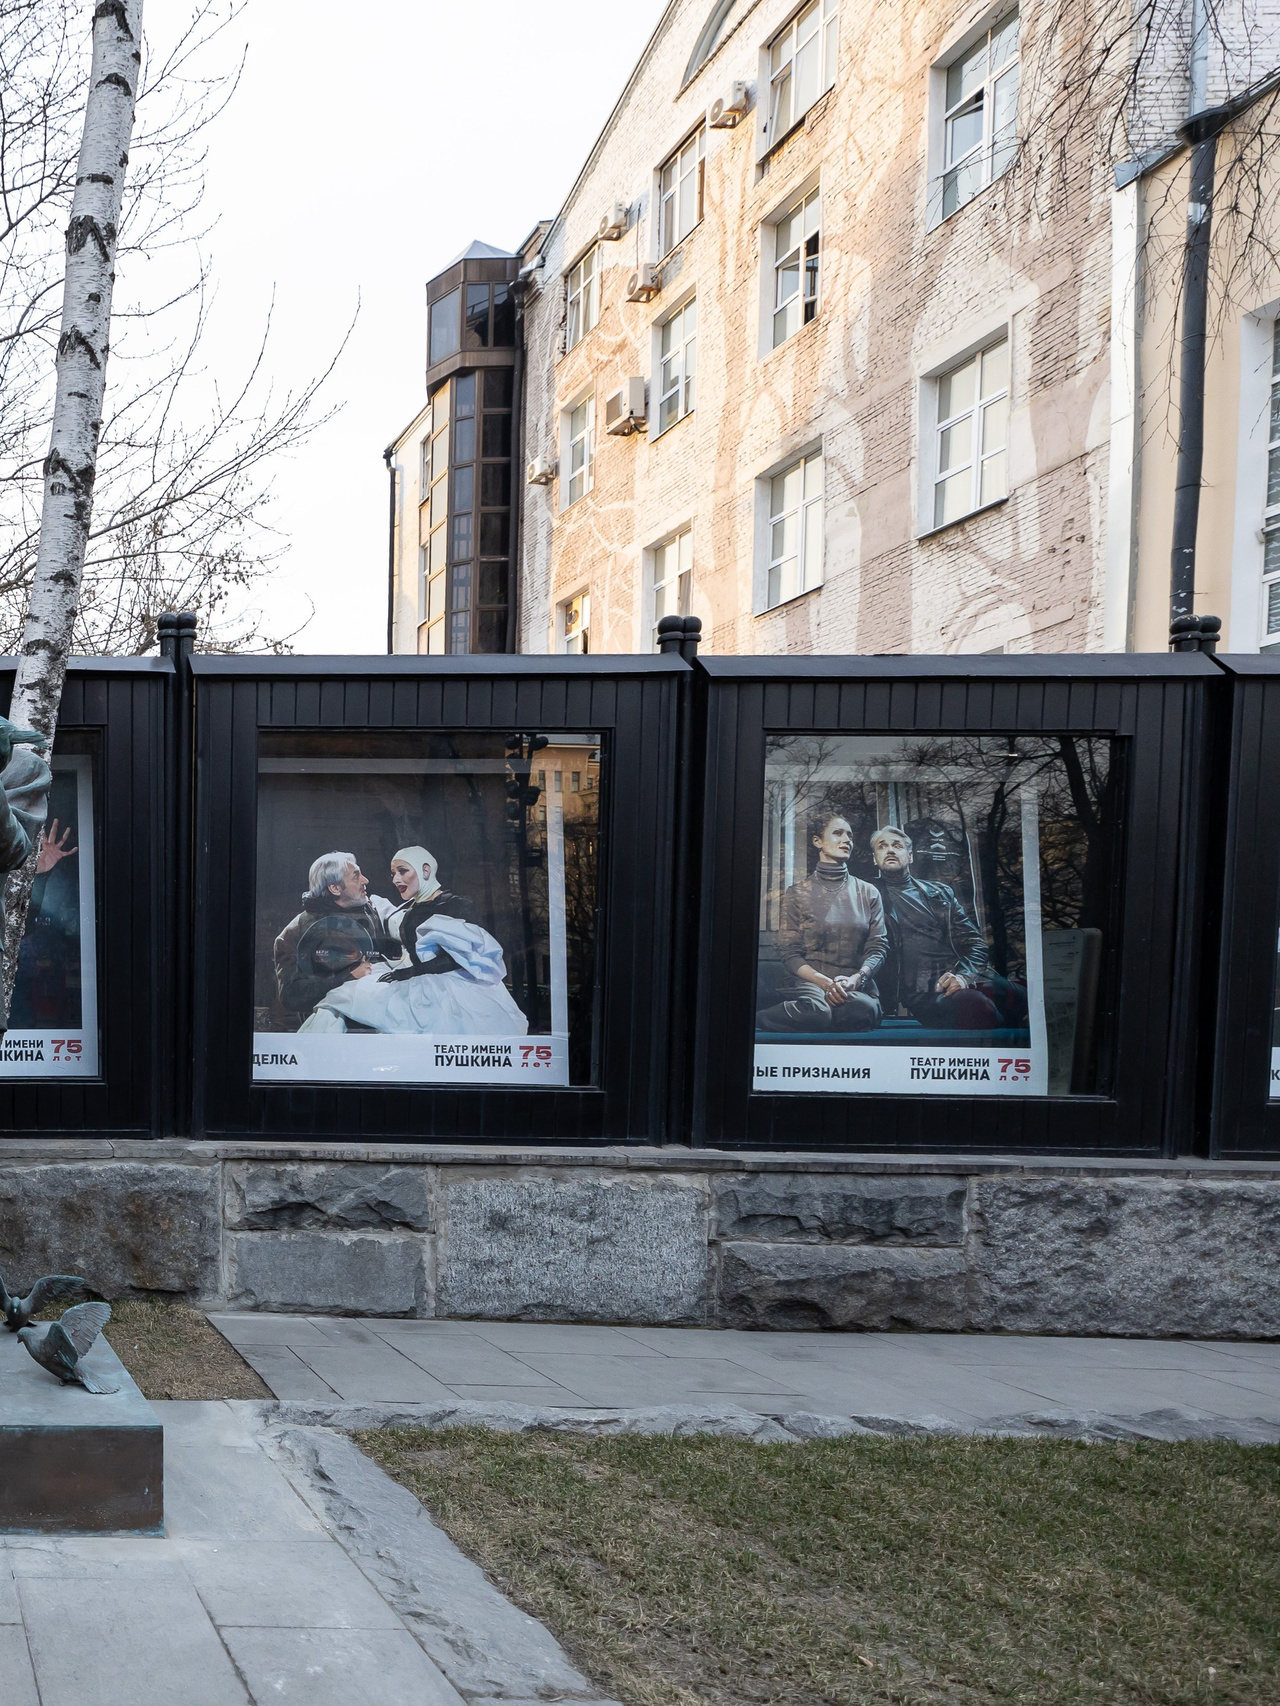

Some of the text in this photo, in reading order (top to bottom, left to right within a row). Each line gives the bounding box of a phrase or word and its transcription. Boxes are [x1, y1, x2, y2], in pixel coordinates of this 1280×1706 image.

[5, 1039, 44, 1049] ИМЕНИ
[50, 1039, 83, 1054] 75
[433, 1044, 512, 1054] ТЕАТР ИМЕНИ
[518, 1045, 553, 1060] 75
[434, 1055, 513, 1068] ПУШКИНА
[909, 1057, 990, 1067] ТЕАТР ИМЕНИ
[997, 1058, 1031, 1074] 75
[753, 1066, 871, 1079] ЫЕ ПРИЗНАНИЯ
[910, 1067, 991, 1081] ПУШКИНА
